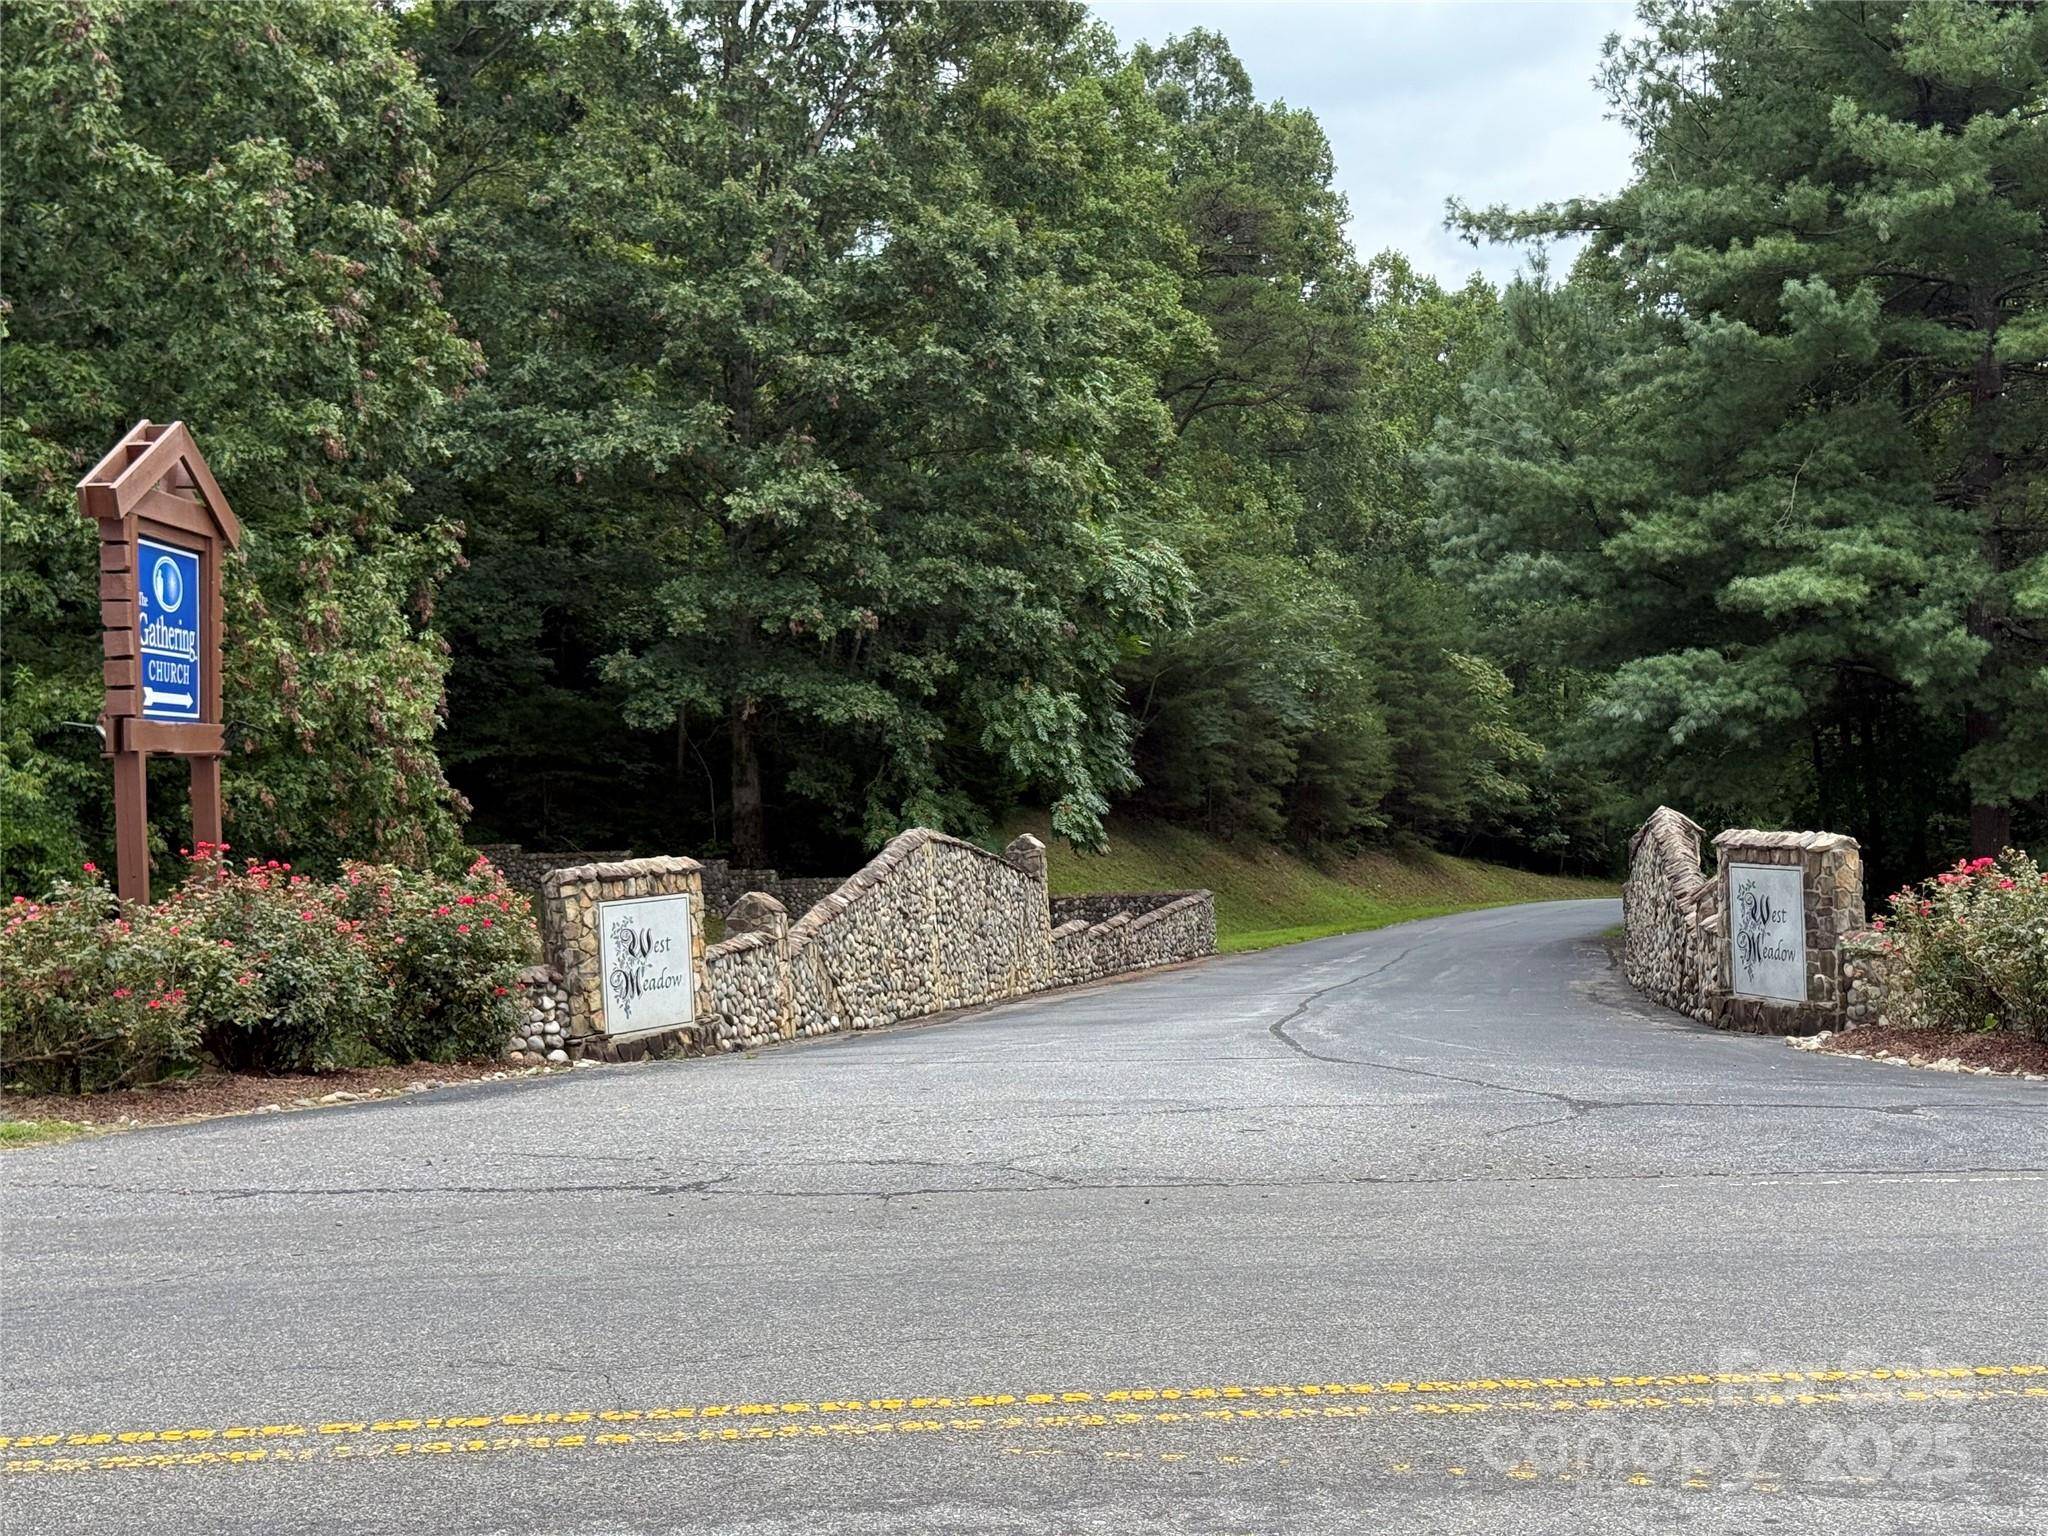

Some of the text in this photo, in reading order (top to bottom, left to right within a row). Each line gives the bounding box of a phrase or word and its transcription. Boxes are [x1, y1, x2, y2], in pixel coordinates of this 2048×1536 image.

[139, 592, 149, 607] The
[139, 612, 196, 662] Gathering
[148, 659, 190, 685] CHURCH
[1744, 892, 1787, 926] West
[619, 928, 672, 958] West
[1737, 931, 1796, 963] Meadow
[610, 966, 682, 999] Meadow
